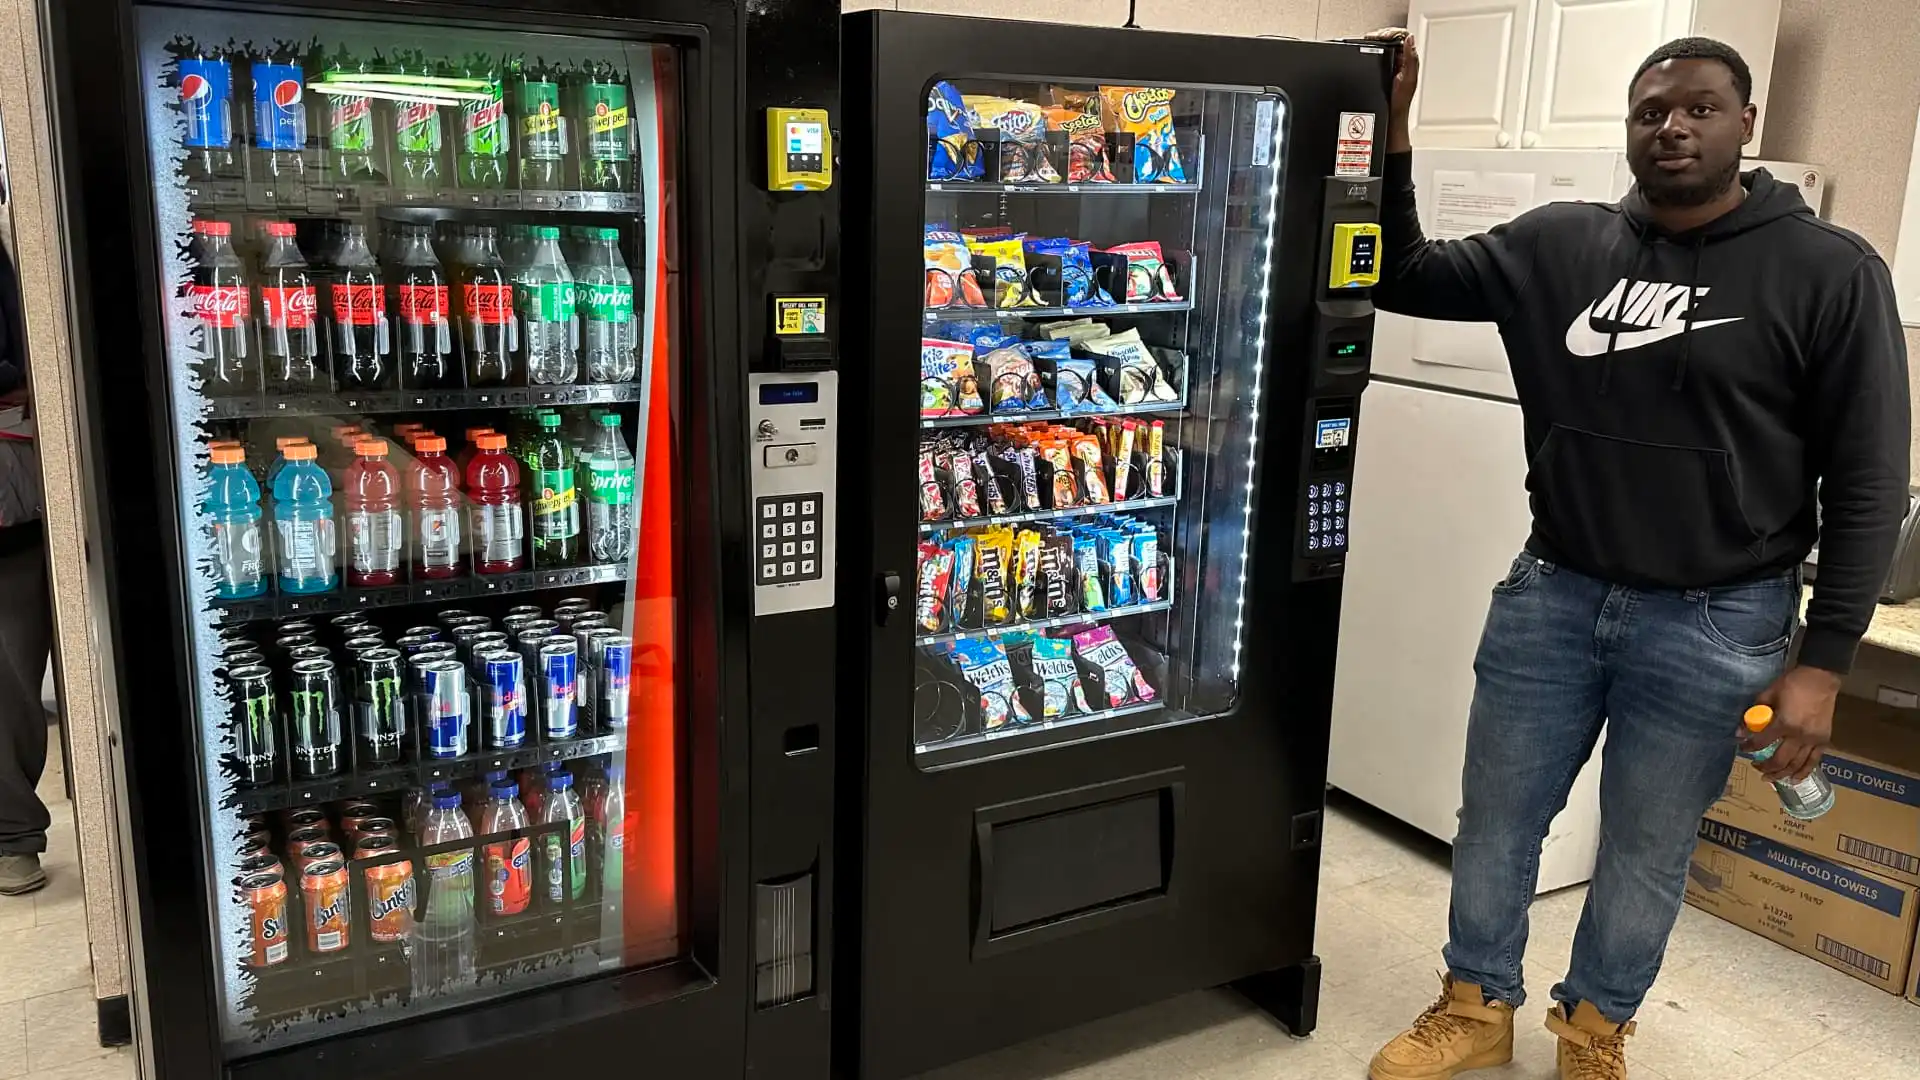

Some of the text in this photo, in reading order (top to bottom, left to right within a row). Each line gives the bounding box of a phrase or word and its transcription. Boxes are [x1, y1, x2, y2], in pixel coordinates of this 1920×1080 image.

[1125, 88, 1169, 120] Cheetos
[991, 111, 1034, 131] Fritos
[588, 288, 631, 308] Sprite
[1592, 278, 1711, 326] NIKE
[590, 472, 632, 491] Sprite
[968, 662, 1011, 685] Welch's
[1035, 661, 1075, 676] Welch's
[1856, 772, 1906, 796] TOWELS
[1699, 820, 1747, 850] ULINE
[1783, 819, 1806, 831] KRAFT
[1767, 849, 1879, 900] MULTI-FOLD TOWELS
